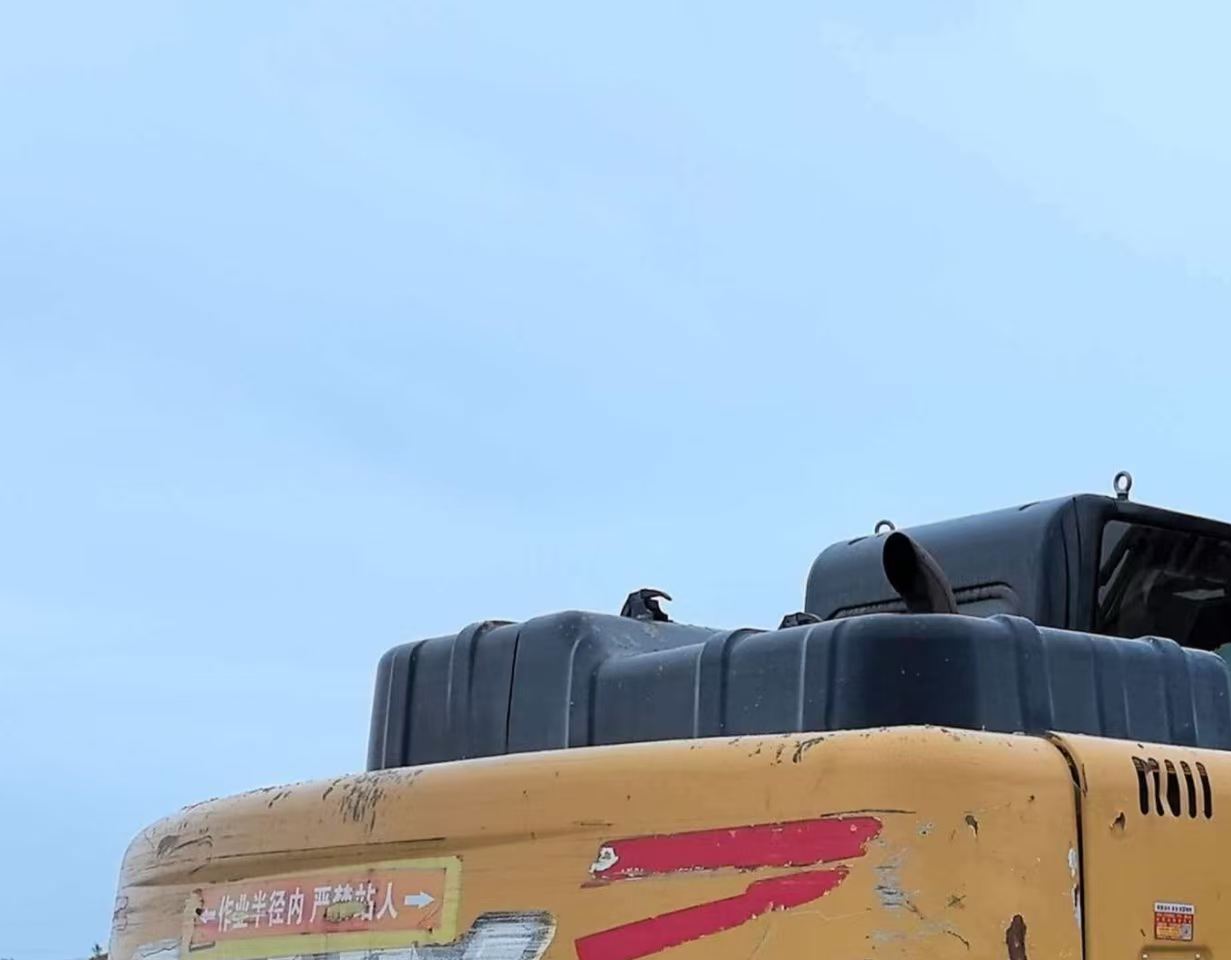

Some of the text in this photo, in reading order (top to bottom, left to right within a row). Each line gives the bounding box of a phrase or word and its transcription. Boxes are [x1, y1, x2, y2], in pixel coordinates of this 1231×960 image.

[218, 886, 305, 933] 作业半径内
